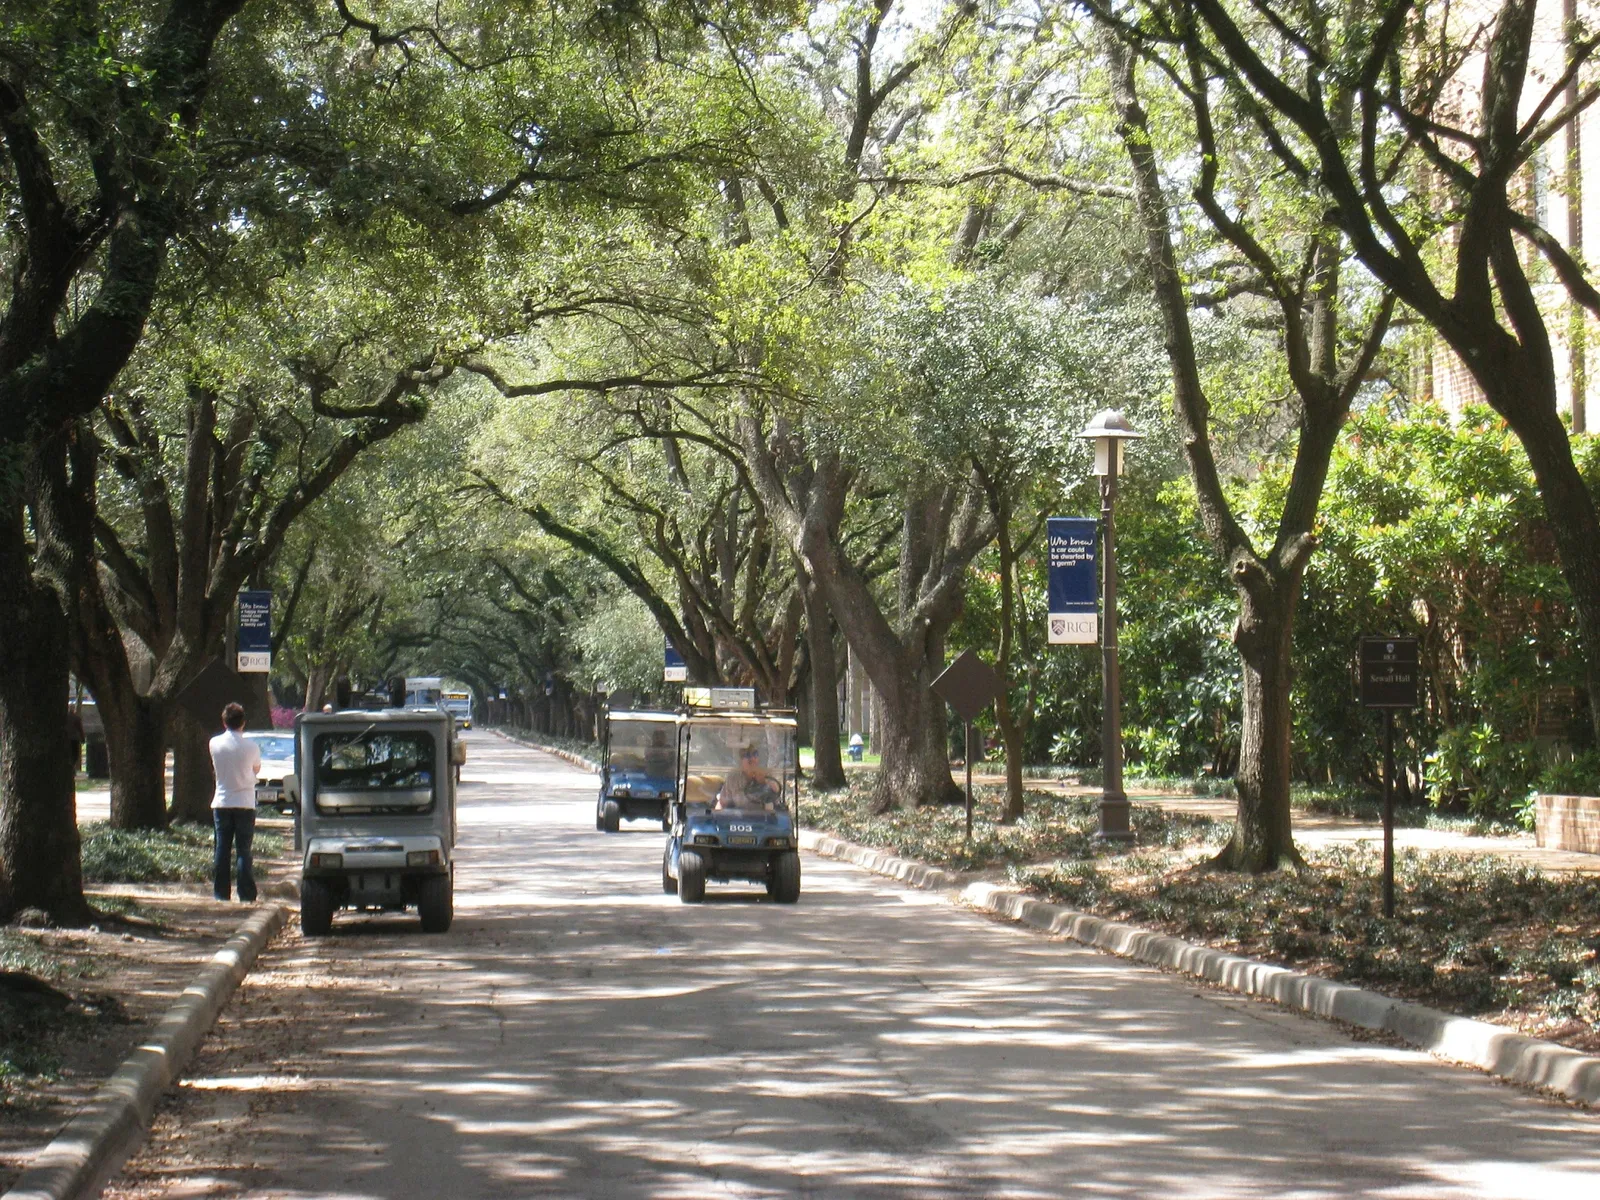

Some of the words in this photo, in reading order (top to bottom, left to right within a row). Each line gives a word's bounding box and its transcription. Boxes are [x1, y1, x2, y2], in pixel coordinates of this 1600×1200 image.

[1050, 536, 1067, 546] Who
[1070, 536, 1093, 546] knew
[1056, 560, 1076, 568] germ?
[1067, 621, 1095, 634] RICE
[250, 657, 269, 666] RICE
[1395, 674, 1411, 682] Hall
